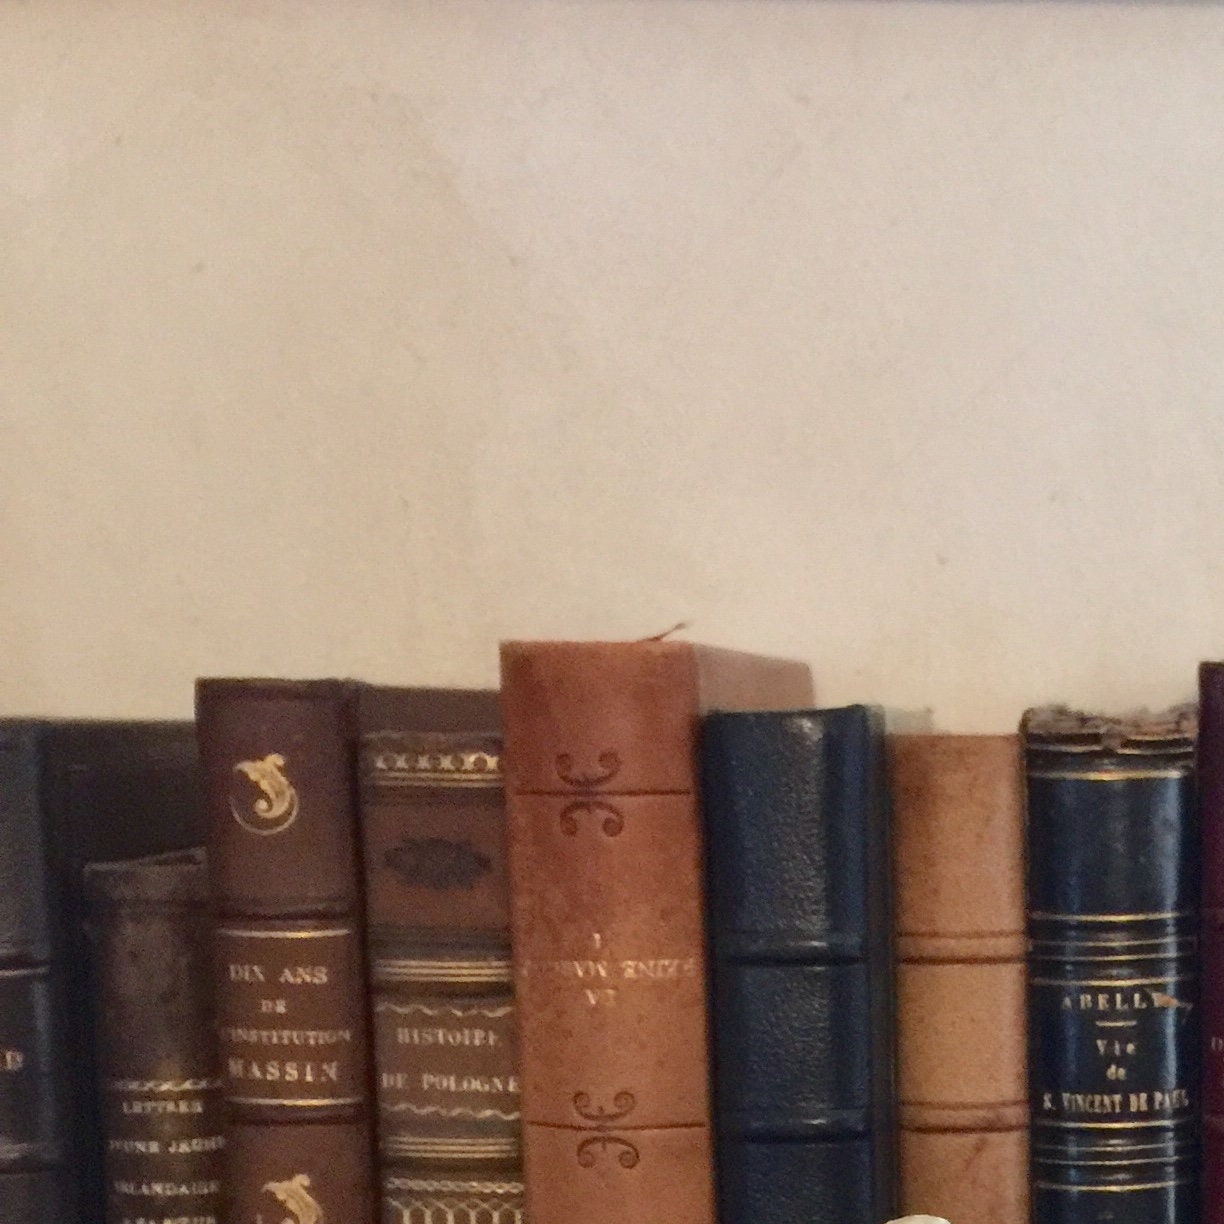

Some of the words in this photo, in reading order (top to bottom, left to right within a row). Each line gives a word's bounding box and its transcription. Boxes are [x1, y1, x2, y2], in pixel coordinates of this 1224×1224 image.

[228, 964, 265, 982] DIX
[279, 966, 329, 985] ANS
[1096, 1039, 1137, 1055] Vie
[228, 1058, 340, 1082] MASSIN
[1061, 1092, 1122, 1113] VINCENT
[1129, 1092, 1148, 1112] DE
